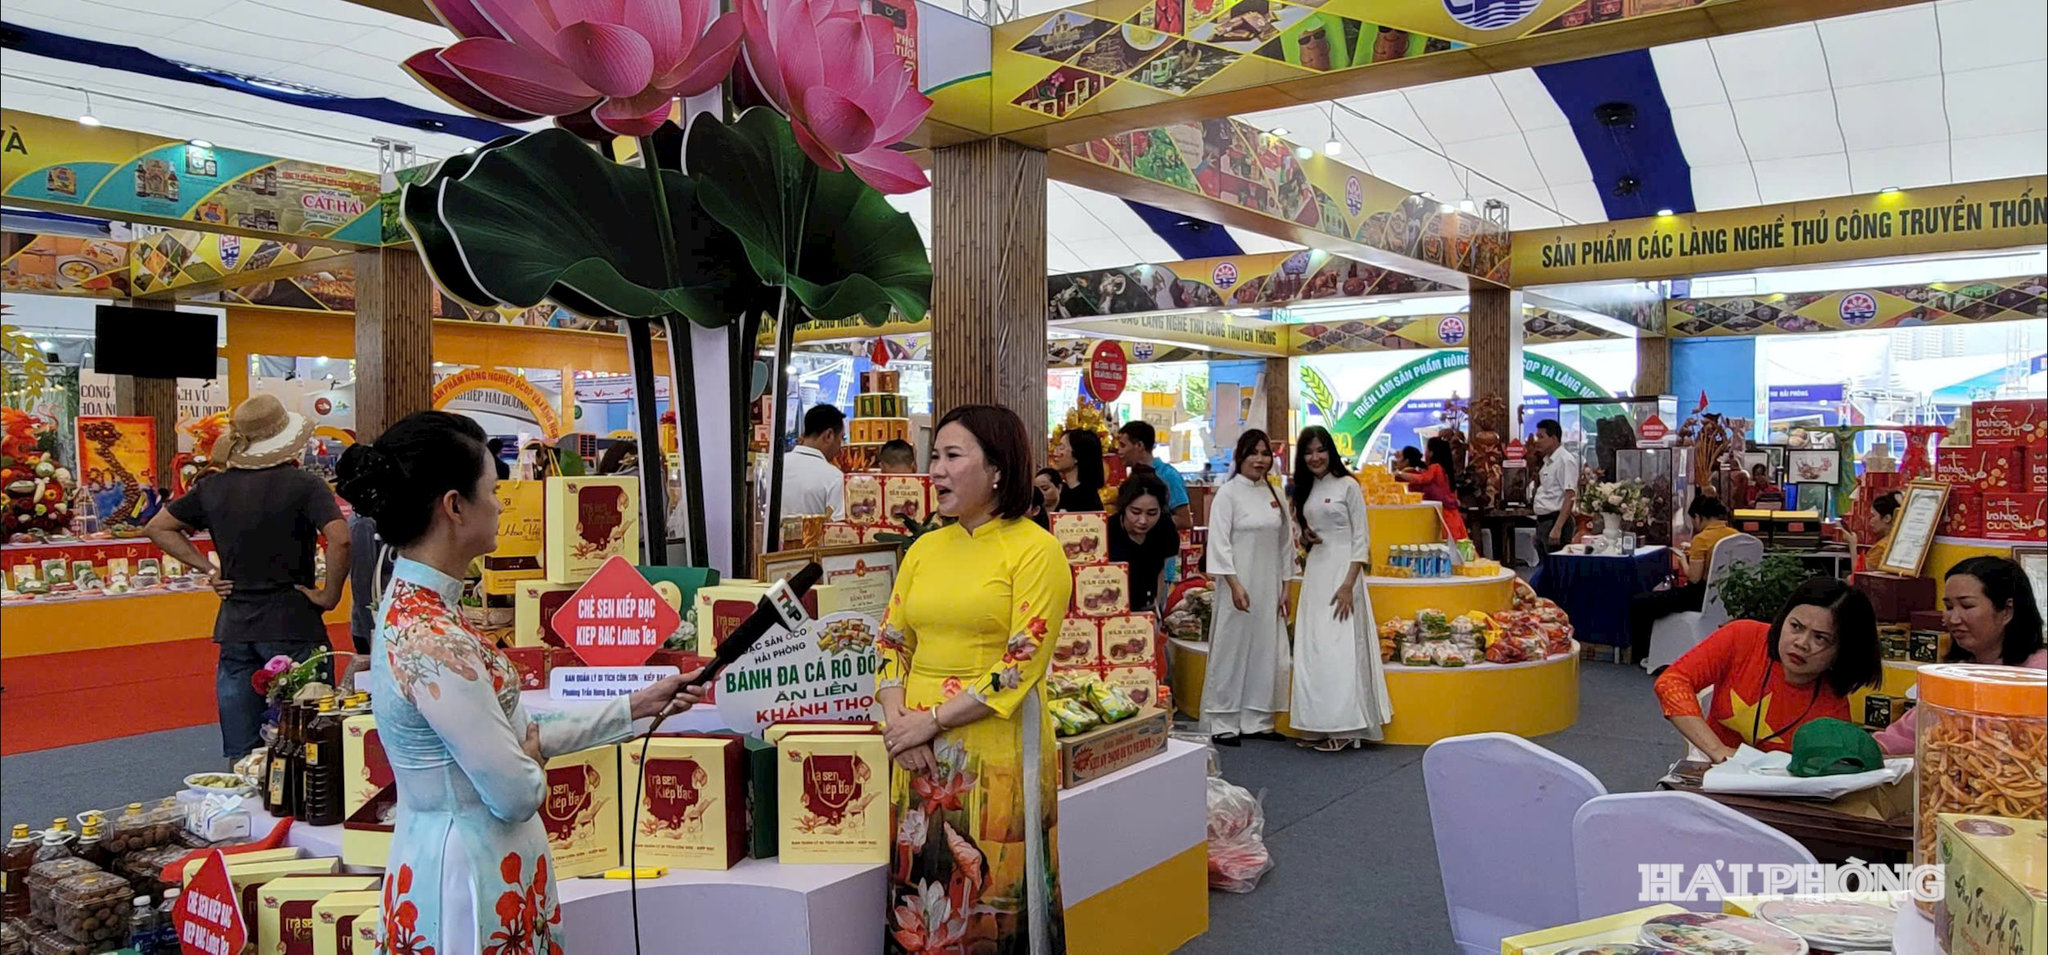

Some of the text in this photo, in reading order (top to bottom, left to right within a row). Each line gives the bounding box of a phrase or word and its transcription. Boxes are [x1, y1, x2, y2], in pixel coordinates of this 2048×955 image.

[1542, 236, 1576, 268] SẢN
[1582, 229, 1632, 265] PHẨM
[1638, 229, 1673, 260] CÁC
[1680, 226, 1727, 257] LÀNG
[1734, 214, 1785, 252] NGHỀ
[1791, 209, 1829, 246] THỦ
[1835, 209, 1892, 242] CÔNG
[1899, 195, 1982, 236] TRUYỀN
[1523, 358, 1540, 372] COP
[578, 591, 656, 623] CHÈ SEN KIẾP BẠC
[576, 625, 657, 646] KIEP BAC Lotus Tea
[765, 635, 784, 647] SẢN
[754, 642, 806, 665] HẢI PHÒNG
[725, 666, 772, 693] BÁNH
[777, 664, 799, 687] ĐA
[805, 656, 827, 683] CÁ
[831, 653, 852, 679] RÔ
[774, 688, 807, 703] ĂN
[756, 702, 828, 723] KHÁNH
[833, 695, 874, 712] THỌ
[662, 775, 677, 786] sen
[822, 771, 839, 782] sen
[552, 783, 569, 796] sen
[197, 893, 210, 919] SEN
[302, 918, 313, 929] se
